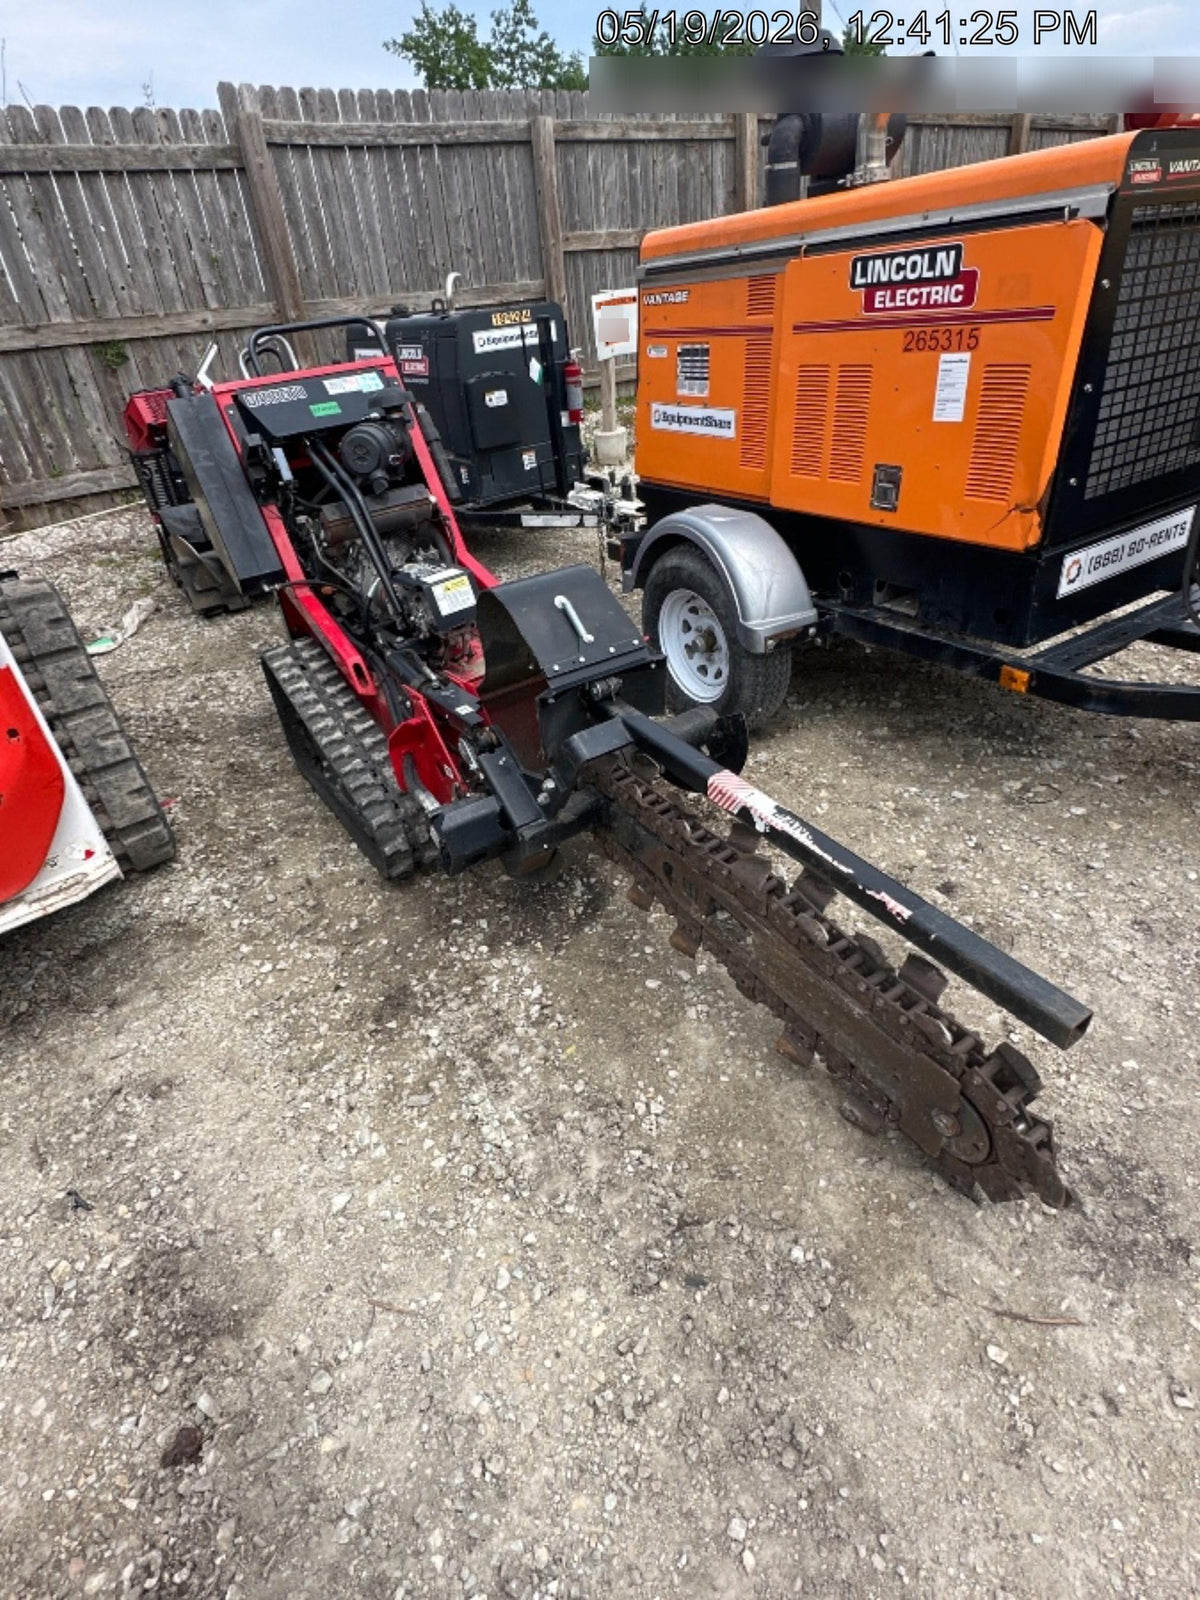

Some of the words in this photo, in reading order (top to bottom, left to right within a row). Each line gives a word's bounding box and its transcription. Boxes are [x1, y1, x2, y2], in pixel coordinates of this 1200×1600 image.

[854, 250, 956, 286] LINCOLN
[643, 290, 689, 305] VANTAGE
[874, 284, 965, 309] ELECTRIC
[903, 327, 980, 353] 265315
[662, 411, 731, 430] EquipmentShare
[1087, 544, 1125, 575] (888)
[1127, 520, 1187, 557] 80-RENTS
